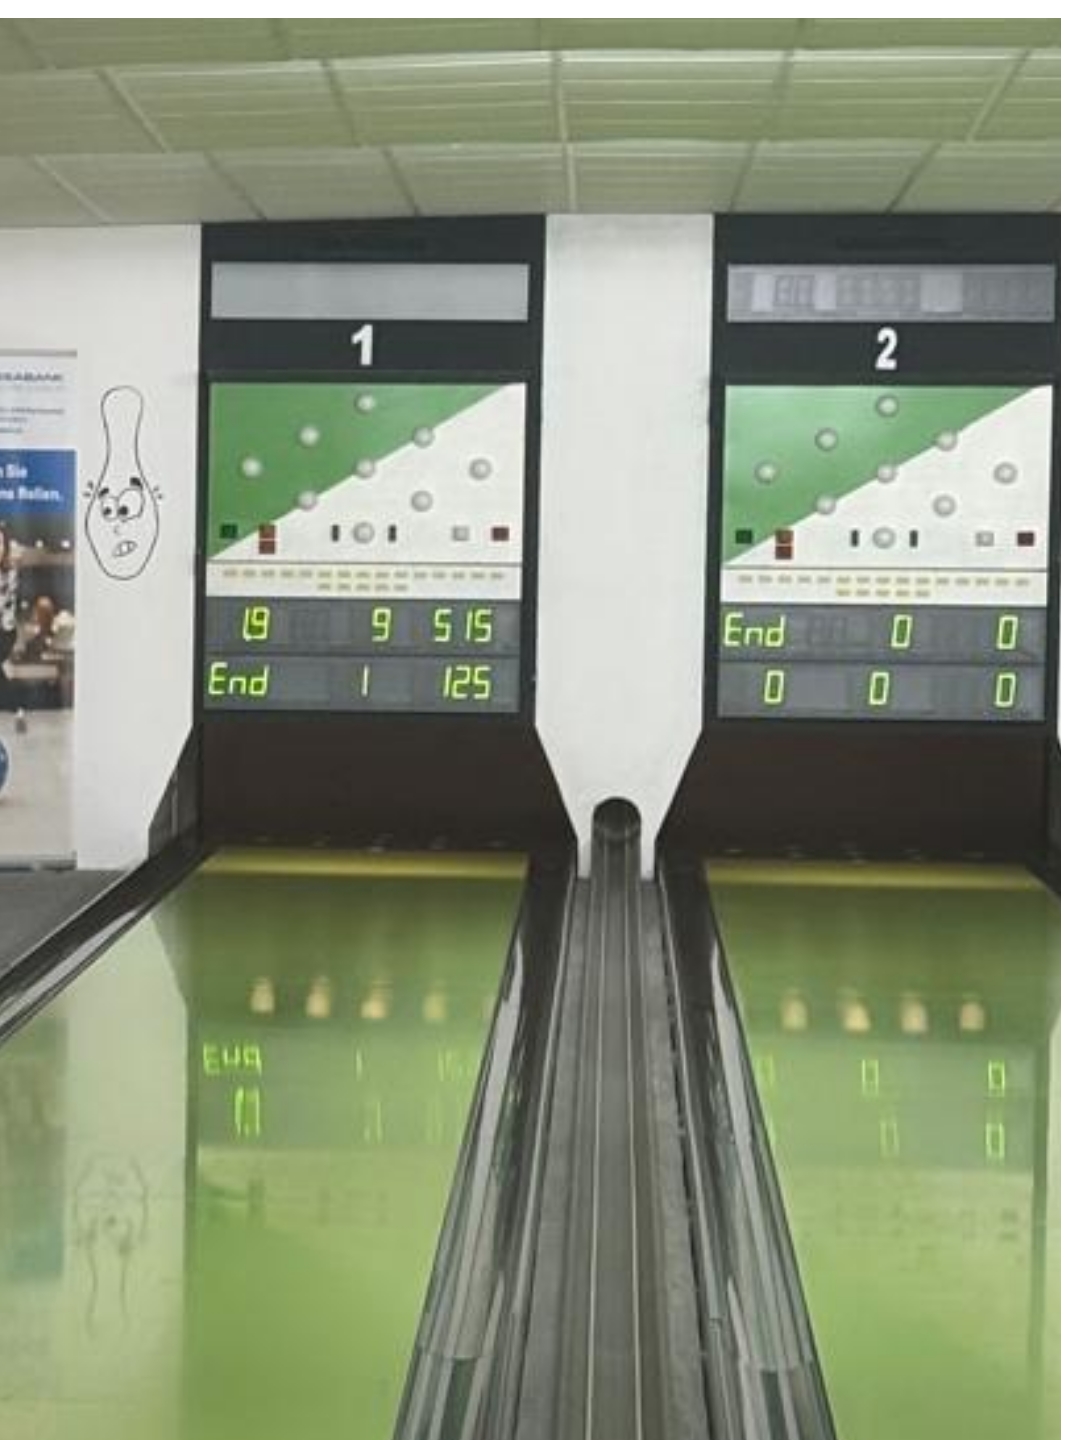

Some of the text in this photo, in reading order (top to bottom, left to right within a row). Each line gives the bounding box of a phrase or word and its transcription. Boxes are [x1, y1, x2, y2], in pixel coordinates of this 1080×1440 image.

[350, 323, 374, 366] 1
[875, 326, 899, 370] 2
[6, 464, 28, 479] Sie
[372, 606, 393, 643] 9
[723, 611, 1019, 651] End 0 0
[207, 660, 492, 700] End 1 125
[763, 669, 1017, 708] 0 0 0
